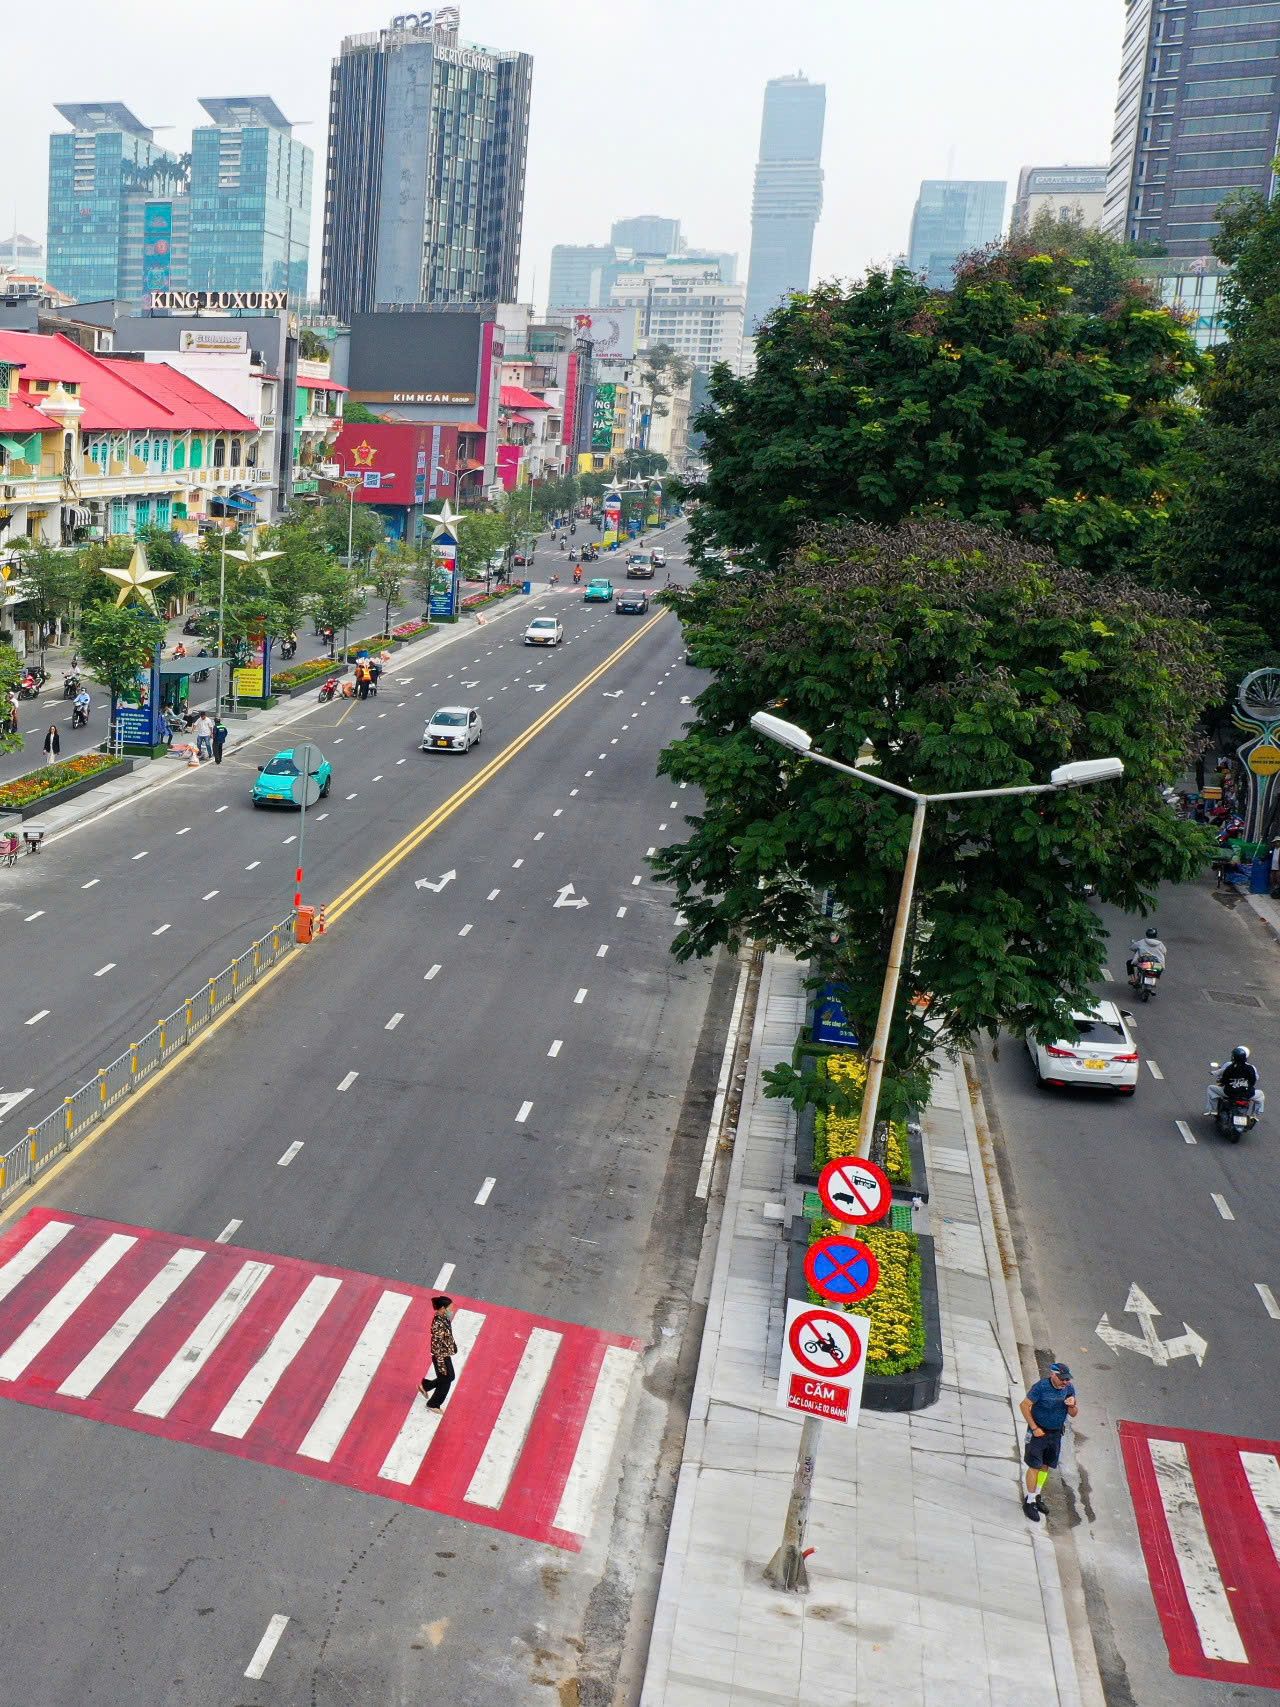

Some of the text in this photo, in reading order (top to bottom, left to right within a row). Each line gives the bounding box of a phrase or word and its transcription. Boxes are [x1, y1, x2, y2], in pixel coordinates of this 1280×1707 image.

[151, 291, 288, 310] KING LUXURY
[804, 1382, 836, 1401] CẤM
[822, 1405, 830, 1413] 02
